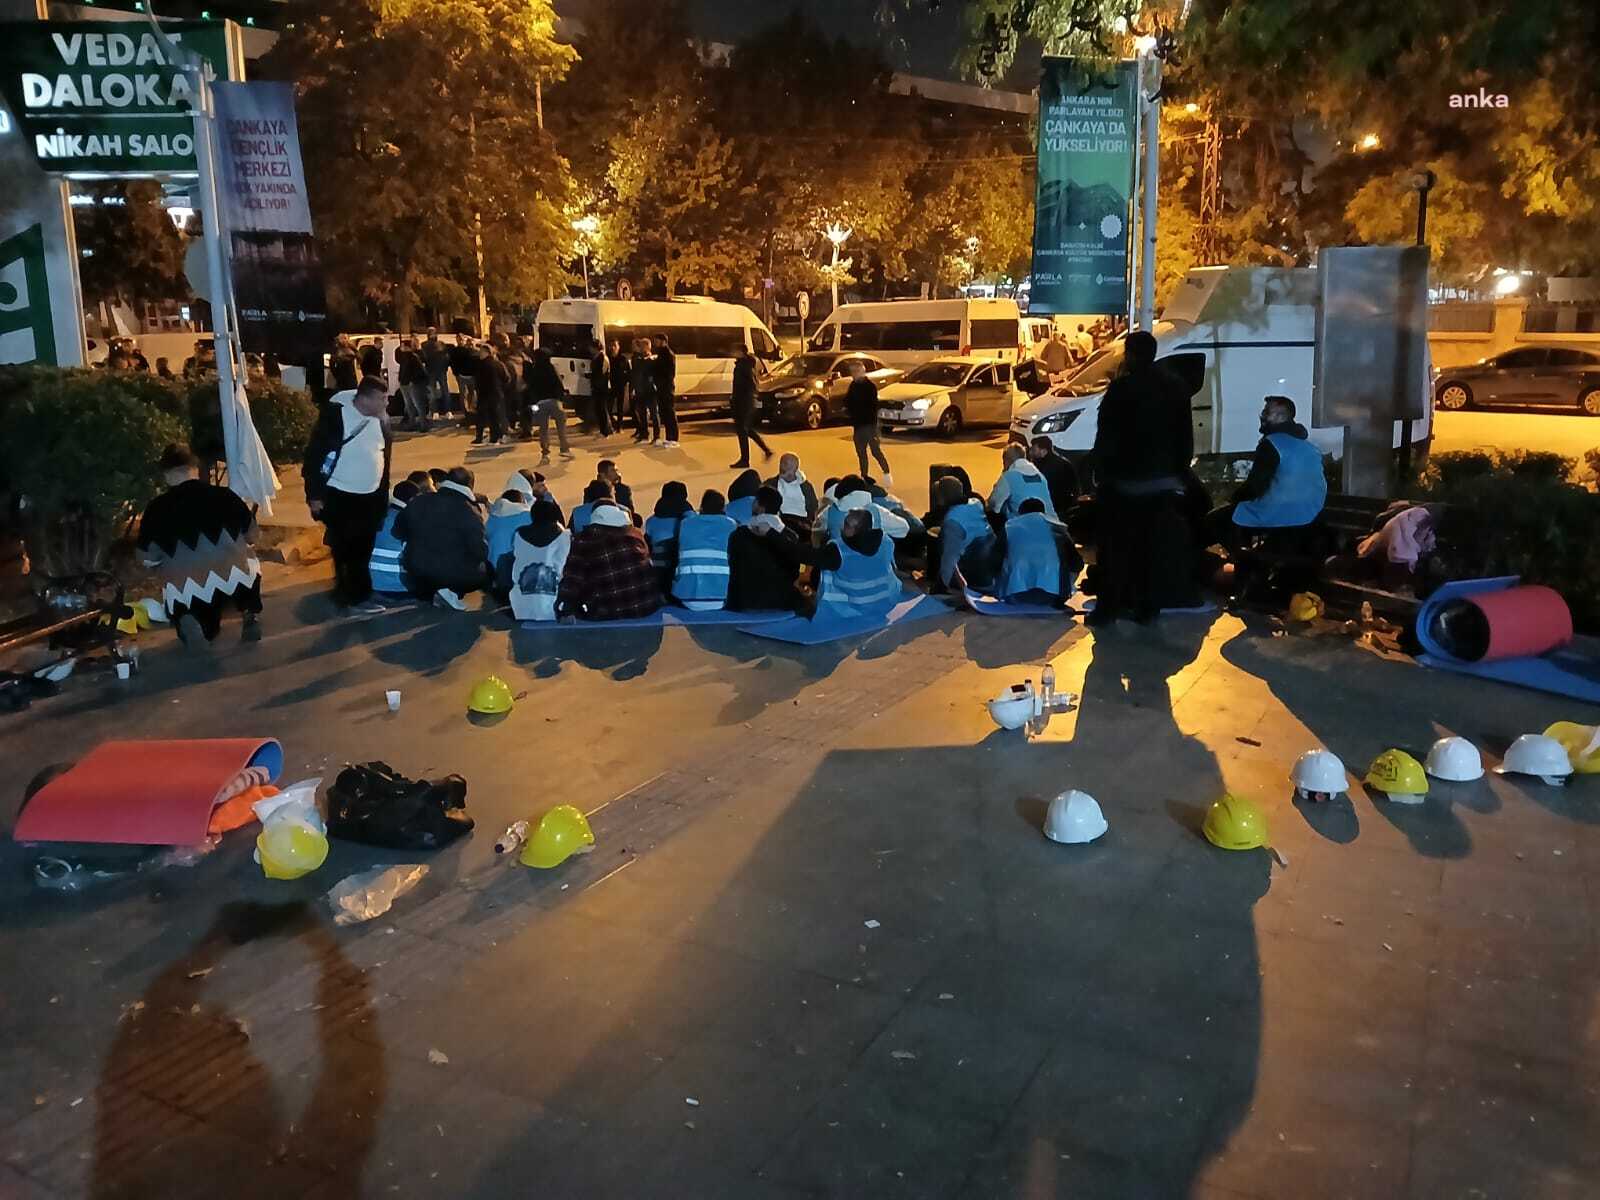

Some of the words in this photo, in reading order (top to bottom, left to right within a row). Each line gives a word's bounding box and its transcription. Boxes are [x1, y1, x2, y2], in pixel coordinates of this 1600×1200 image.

[21, 73, 196, 107] DALOKA
[1045, 119, 1126, 136] ÇANKAYA'DA
[35, 127, 122, 158] NİKAH
[128, 134, 193, 157] SALO
[1044, 136, 1128, 153] YÜKSELİYOR!
[234, 159, 292, 177] MERKEZİ
[255, 183, 297, 194] YAKINDA
